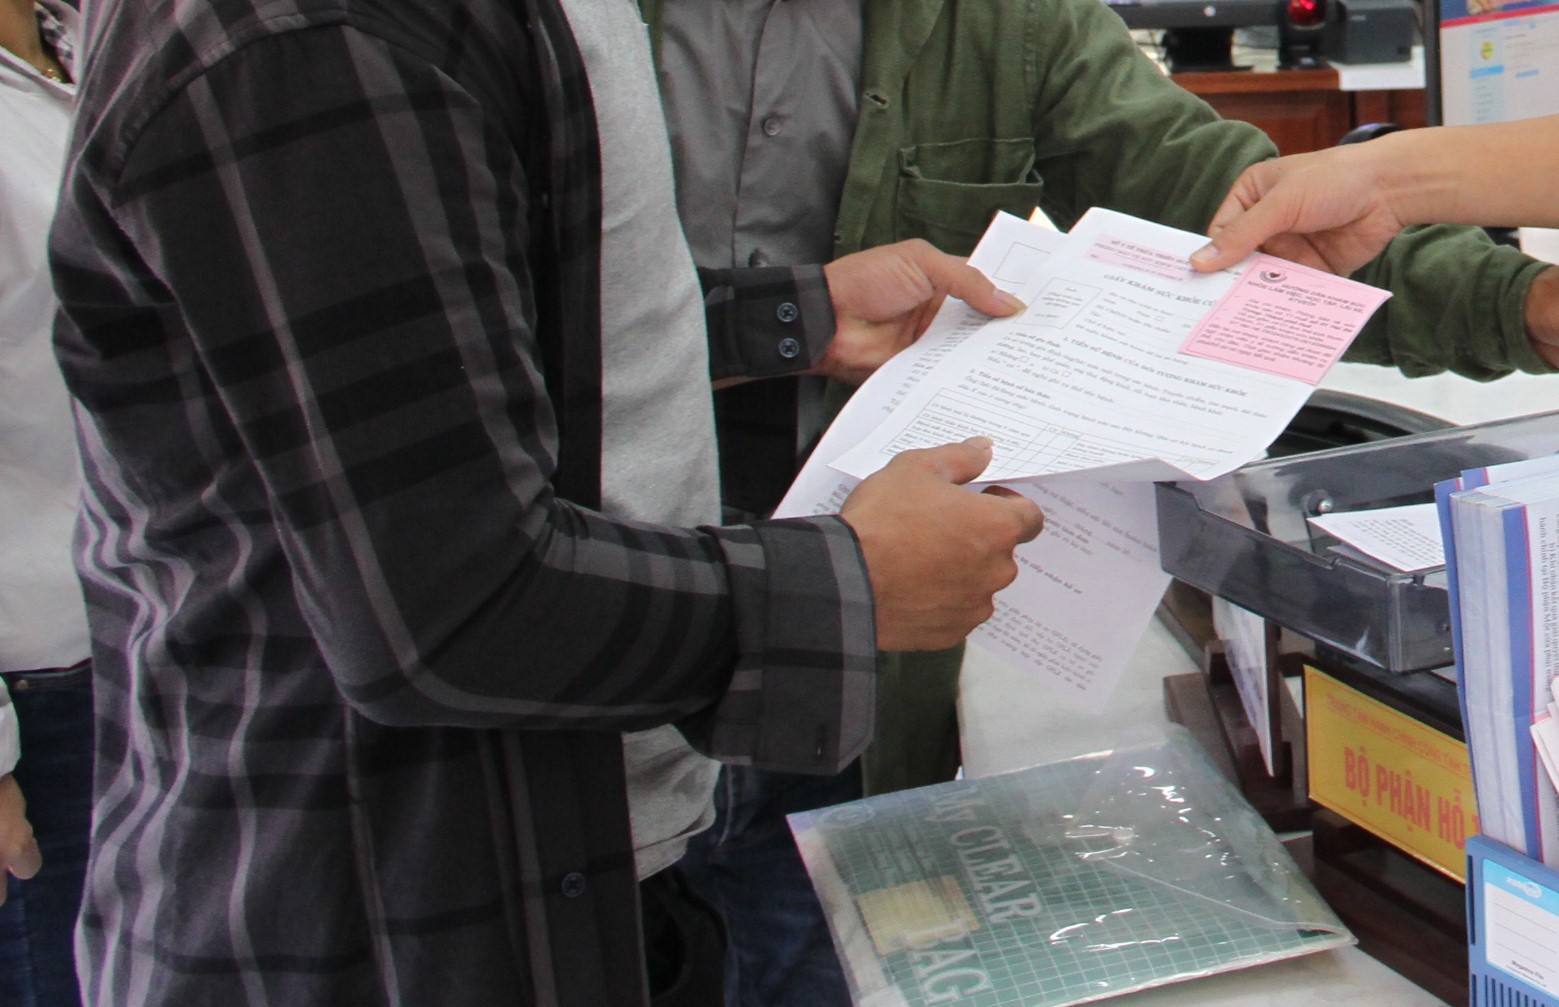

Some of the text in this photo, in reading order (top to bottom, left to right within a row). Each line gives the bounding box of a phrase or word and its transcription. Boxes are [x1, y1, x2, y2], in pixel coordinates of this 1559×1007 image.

[1344, 746, 1370, 807] BỘ
[1376, 763, 1431, 833] PHẬN
[951, 826, 1042, 925] CLEAR
